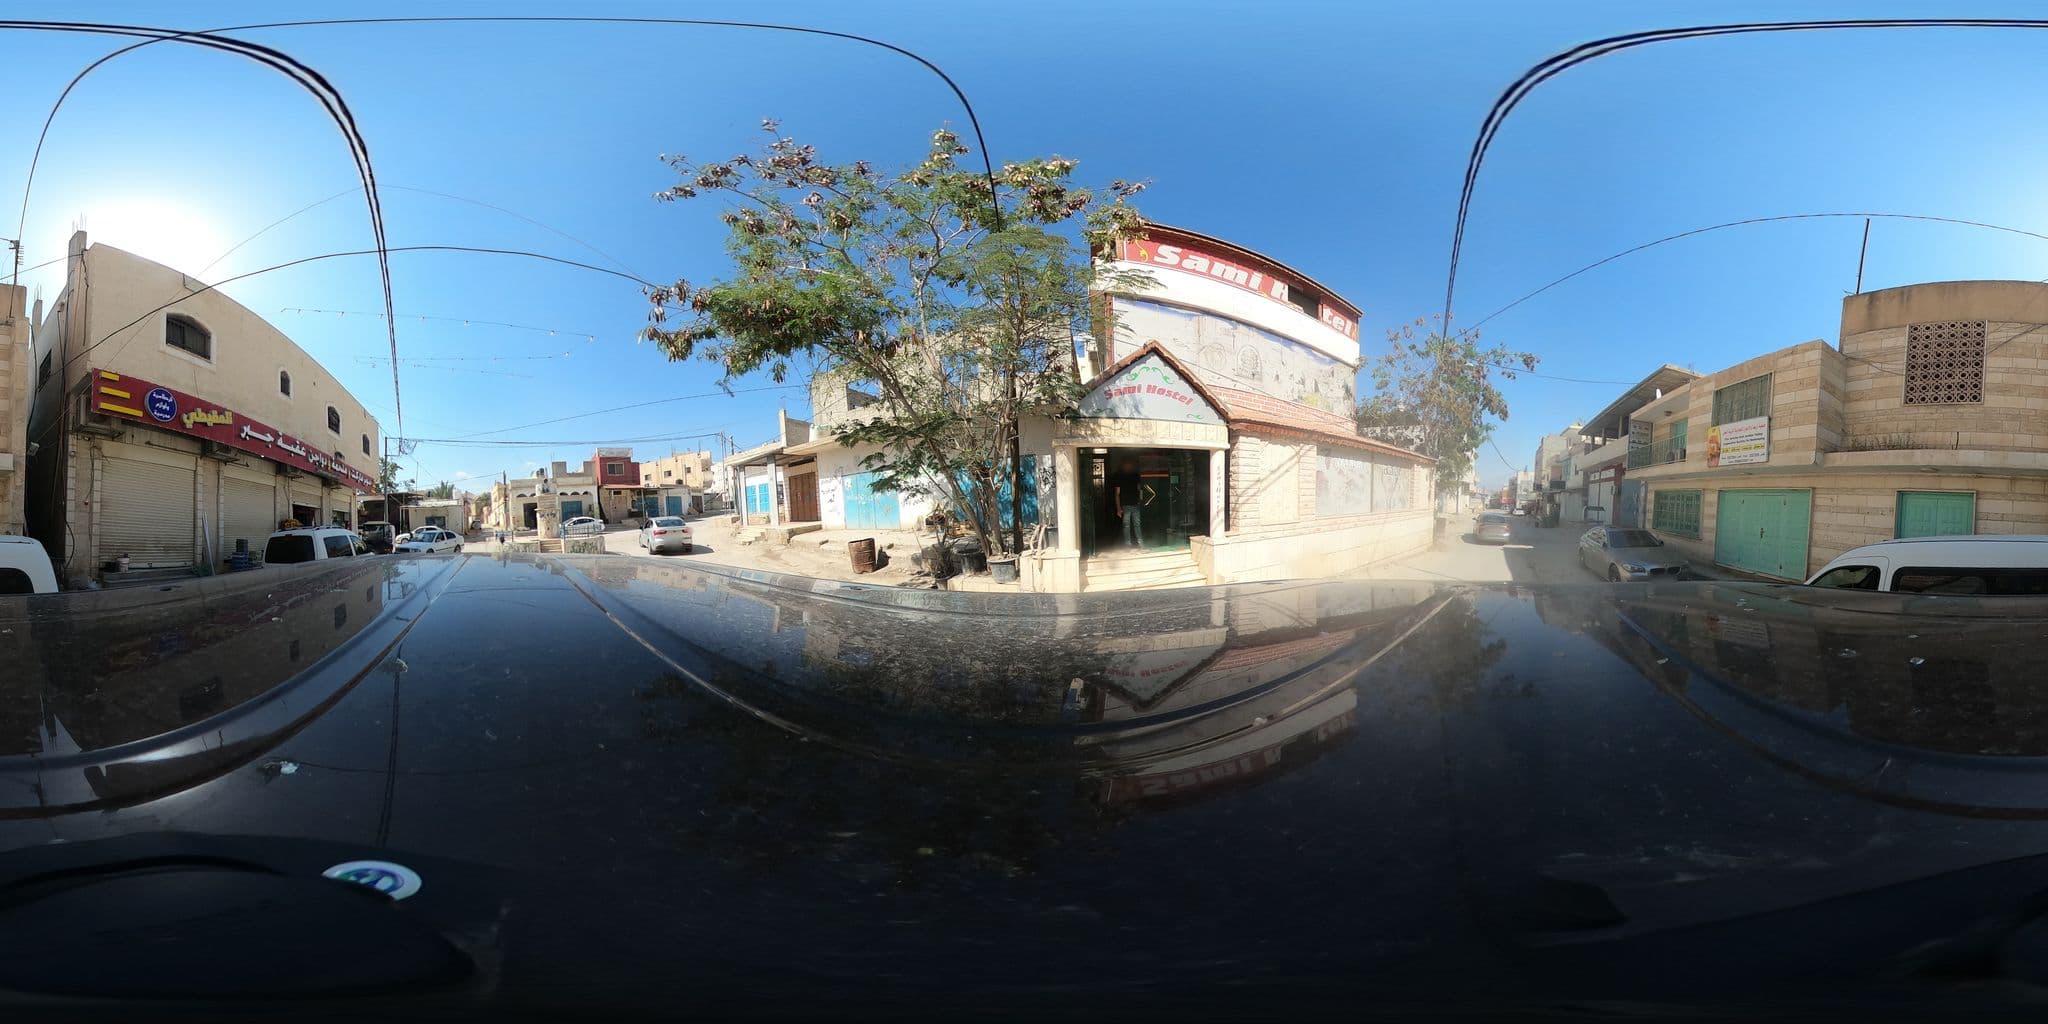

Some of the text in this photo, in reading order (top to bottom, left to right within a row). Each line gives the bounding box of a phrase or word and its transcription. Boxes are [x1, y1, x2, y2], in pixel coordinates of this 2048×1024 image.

[1153, 244, 1352, 337] Sami Htel
[1104, 384, 1193, 406] Sami Hostel
[276, 432, 306, 457] عقبة
